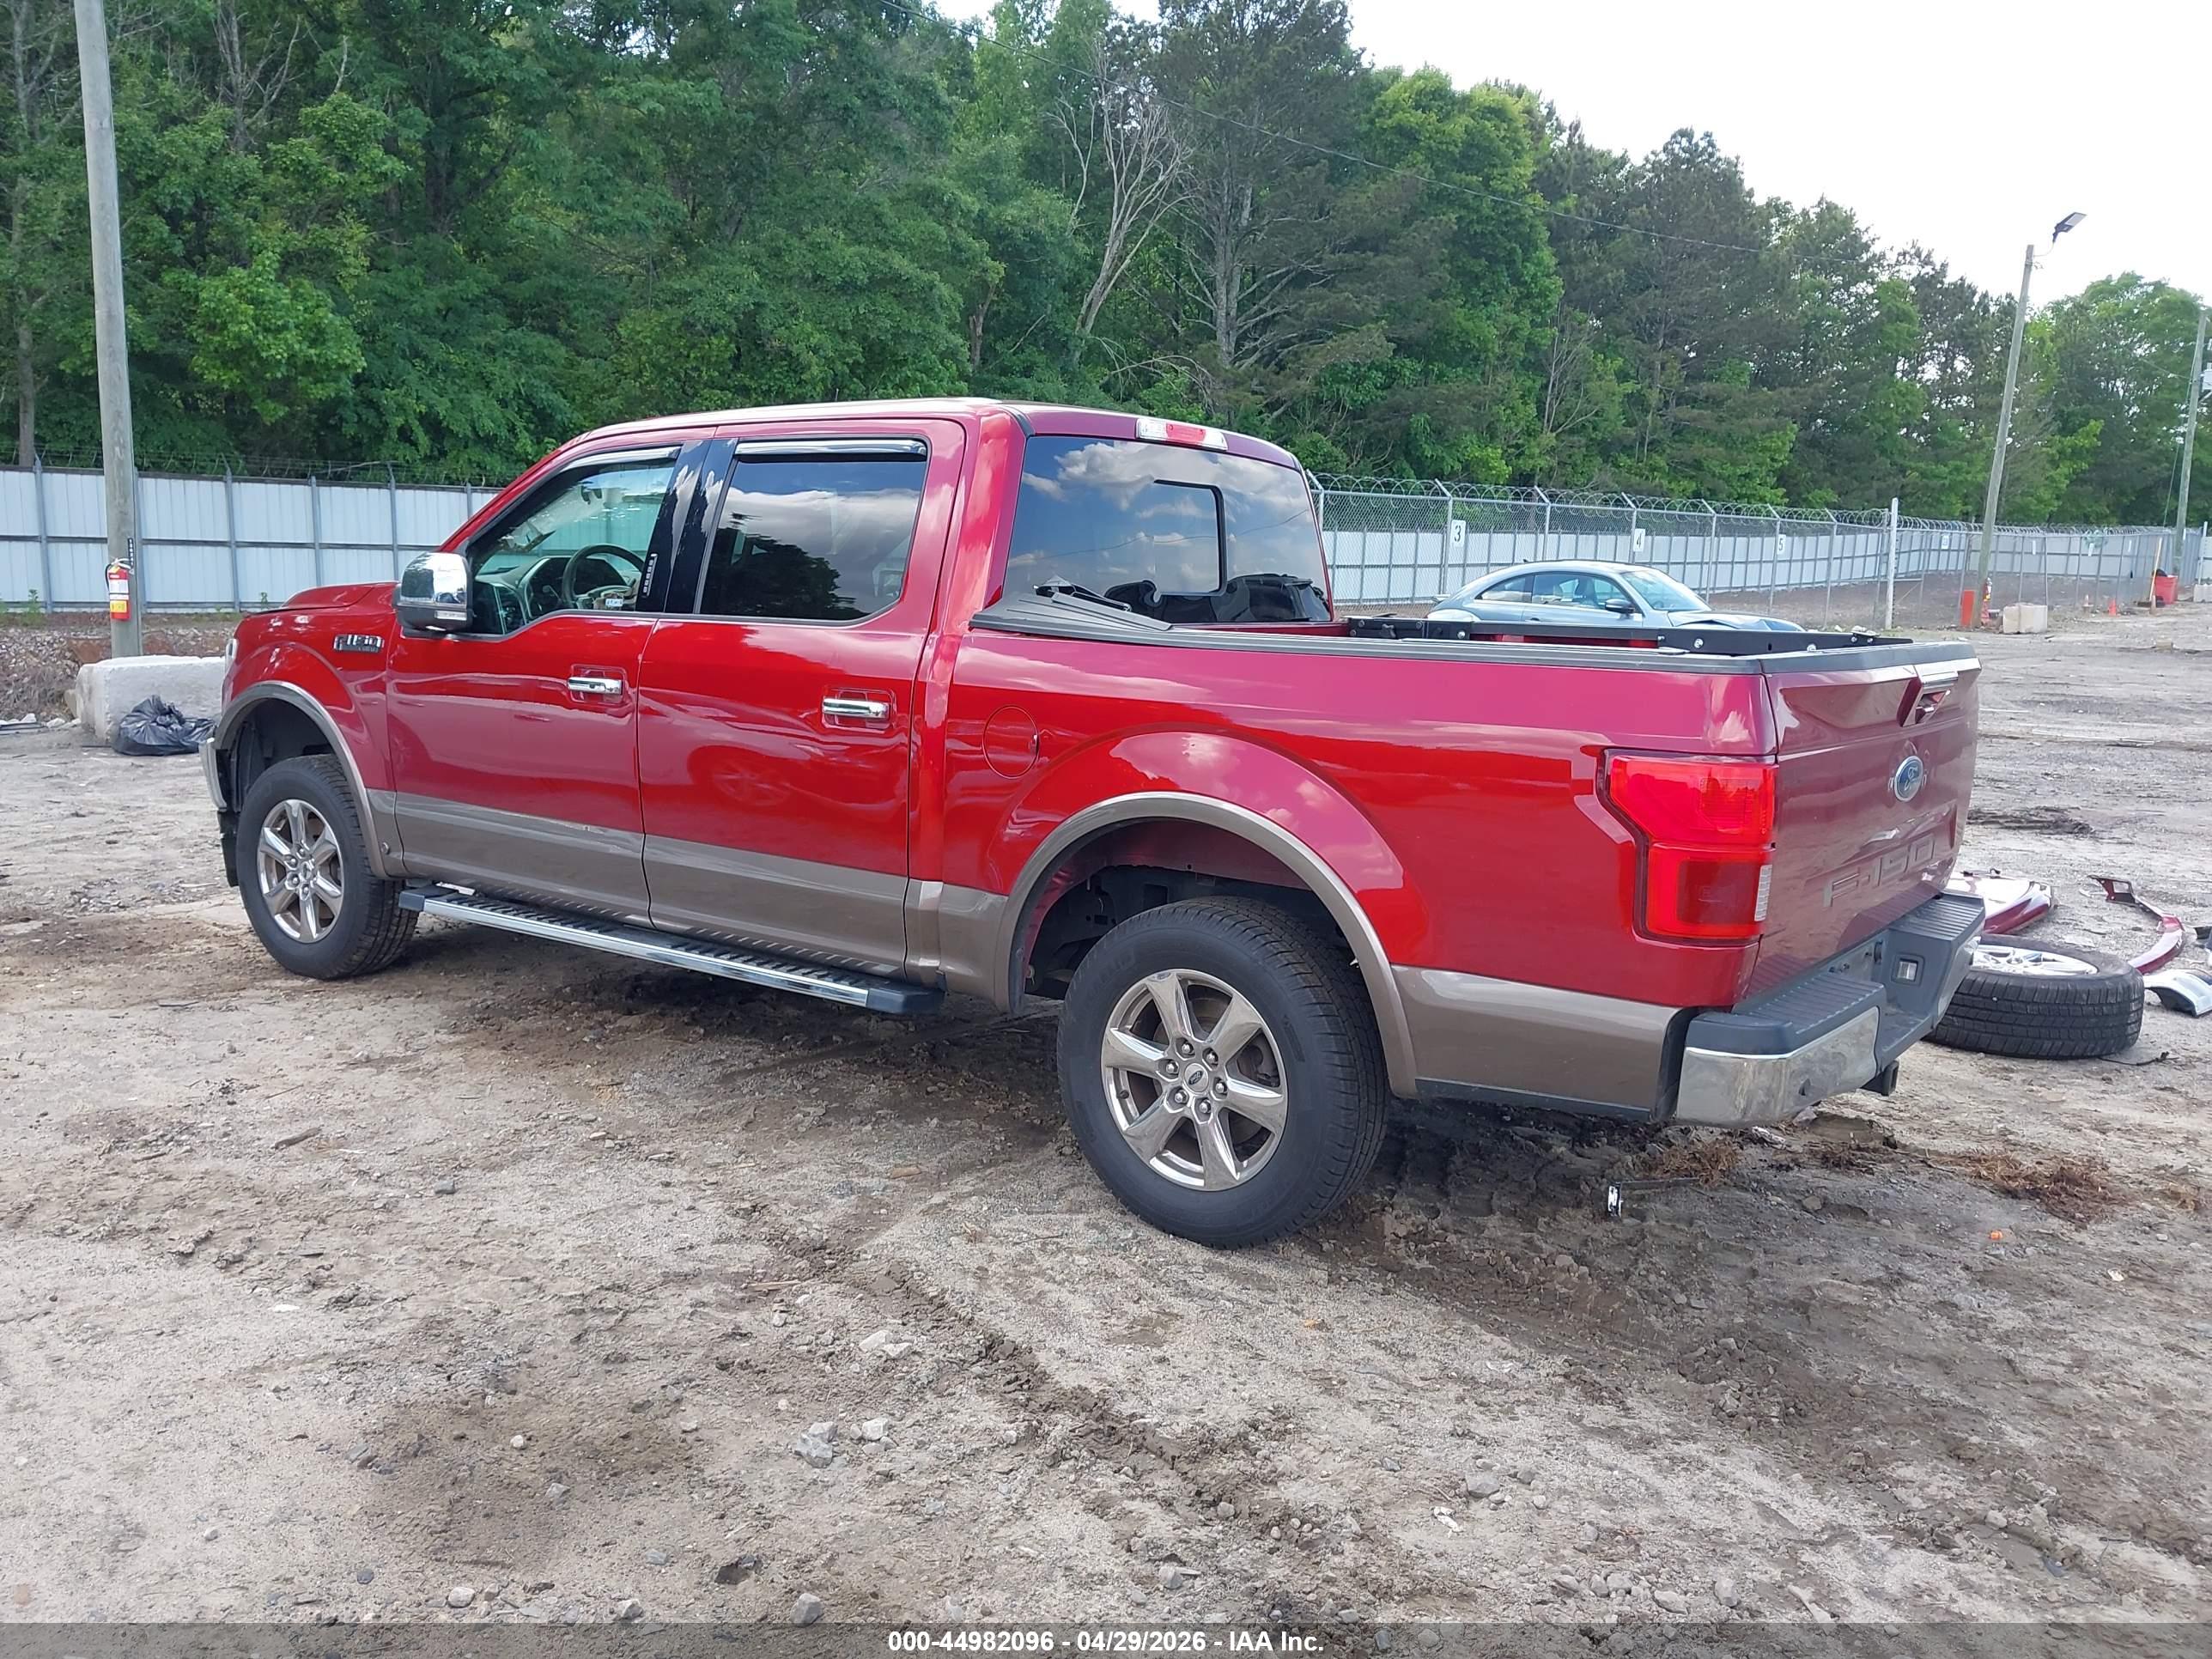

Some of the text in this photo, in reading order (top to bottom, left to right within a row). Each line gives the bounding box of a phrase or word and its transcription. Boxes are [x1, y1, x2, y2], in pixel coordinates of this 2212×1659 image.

[1454, 525, 1462, 542] 3
[1636, 532, 1643, 549] 4
[1778, 538, 1784, 551] 5
